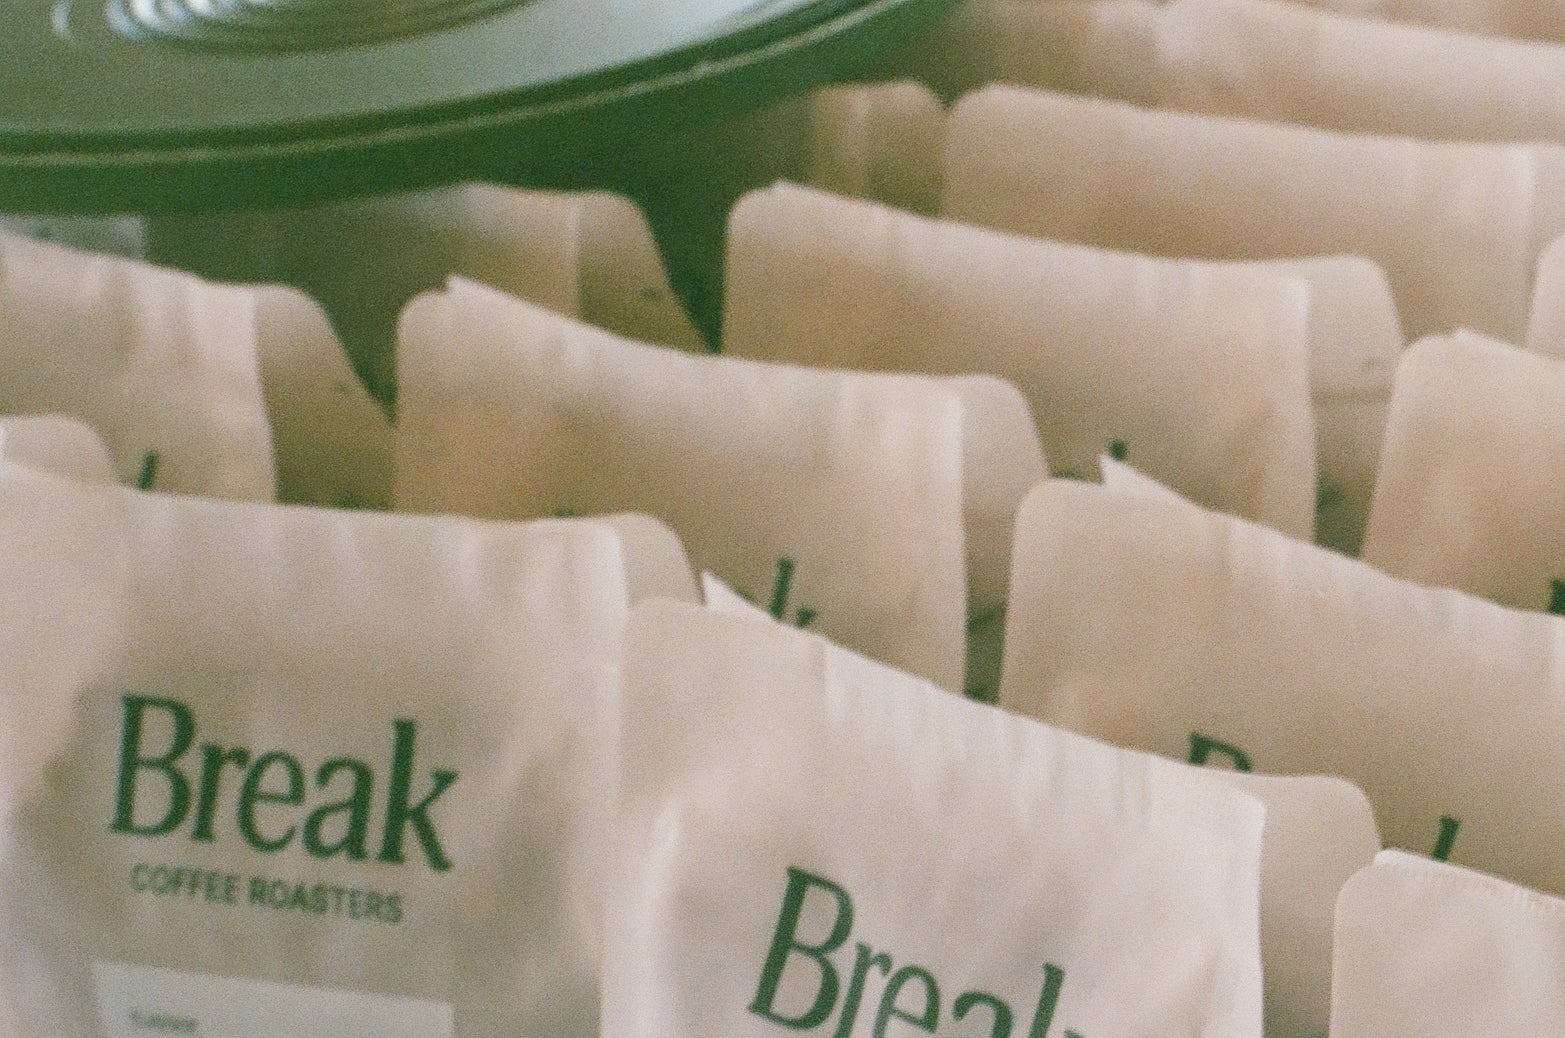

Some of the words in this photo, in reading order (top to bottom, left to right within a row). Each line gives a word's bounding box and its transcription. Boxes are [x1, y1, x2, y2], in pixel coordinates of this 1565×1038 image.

[110, 693, 459, 873] Break
[130, 861, 240, 906] COFFEE
[246, 875, 403, 926] ROASTERS
